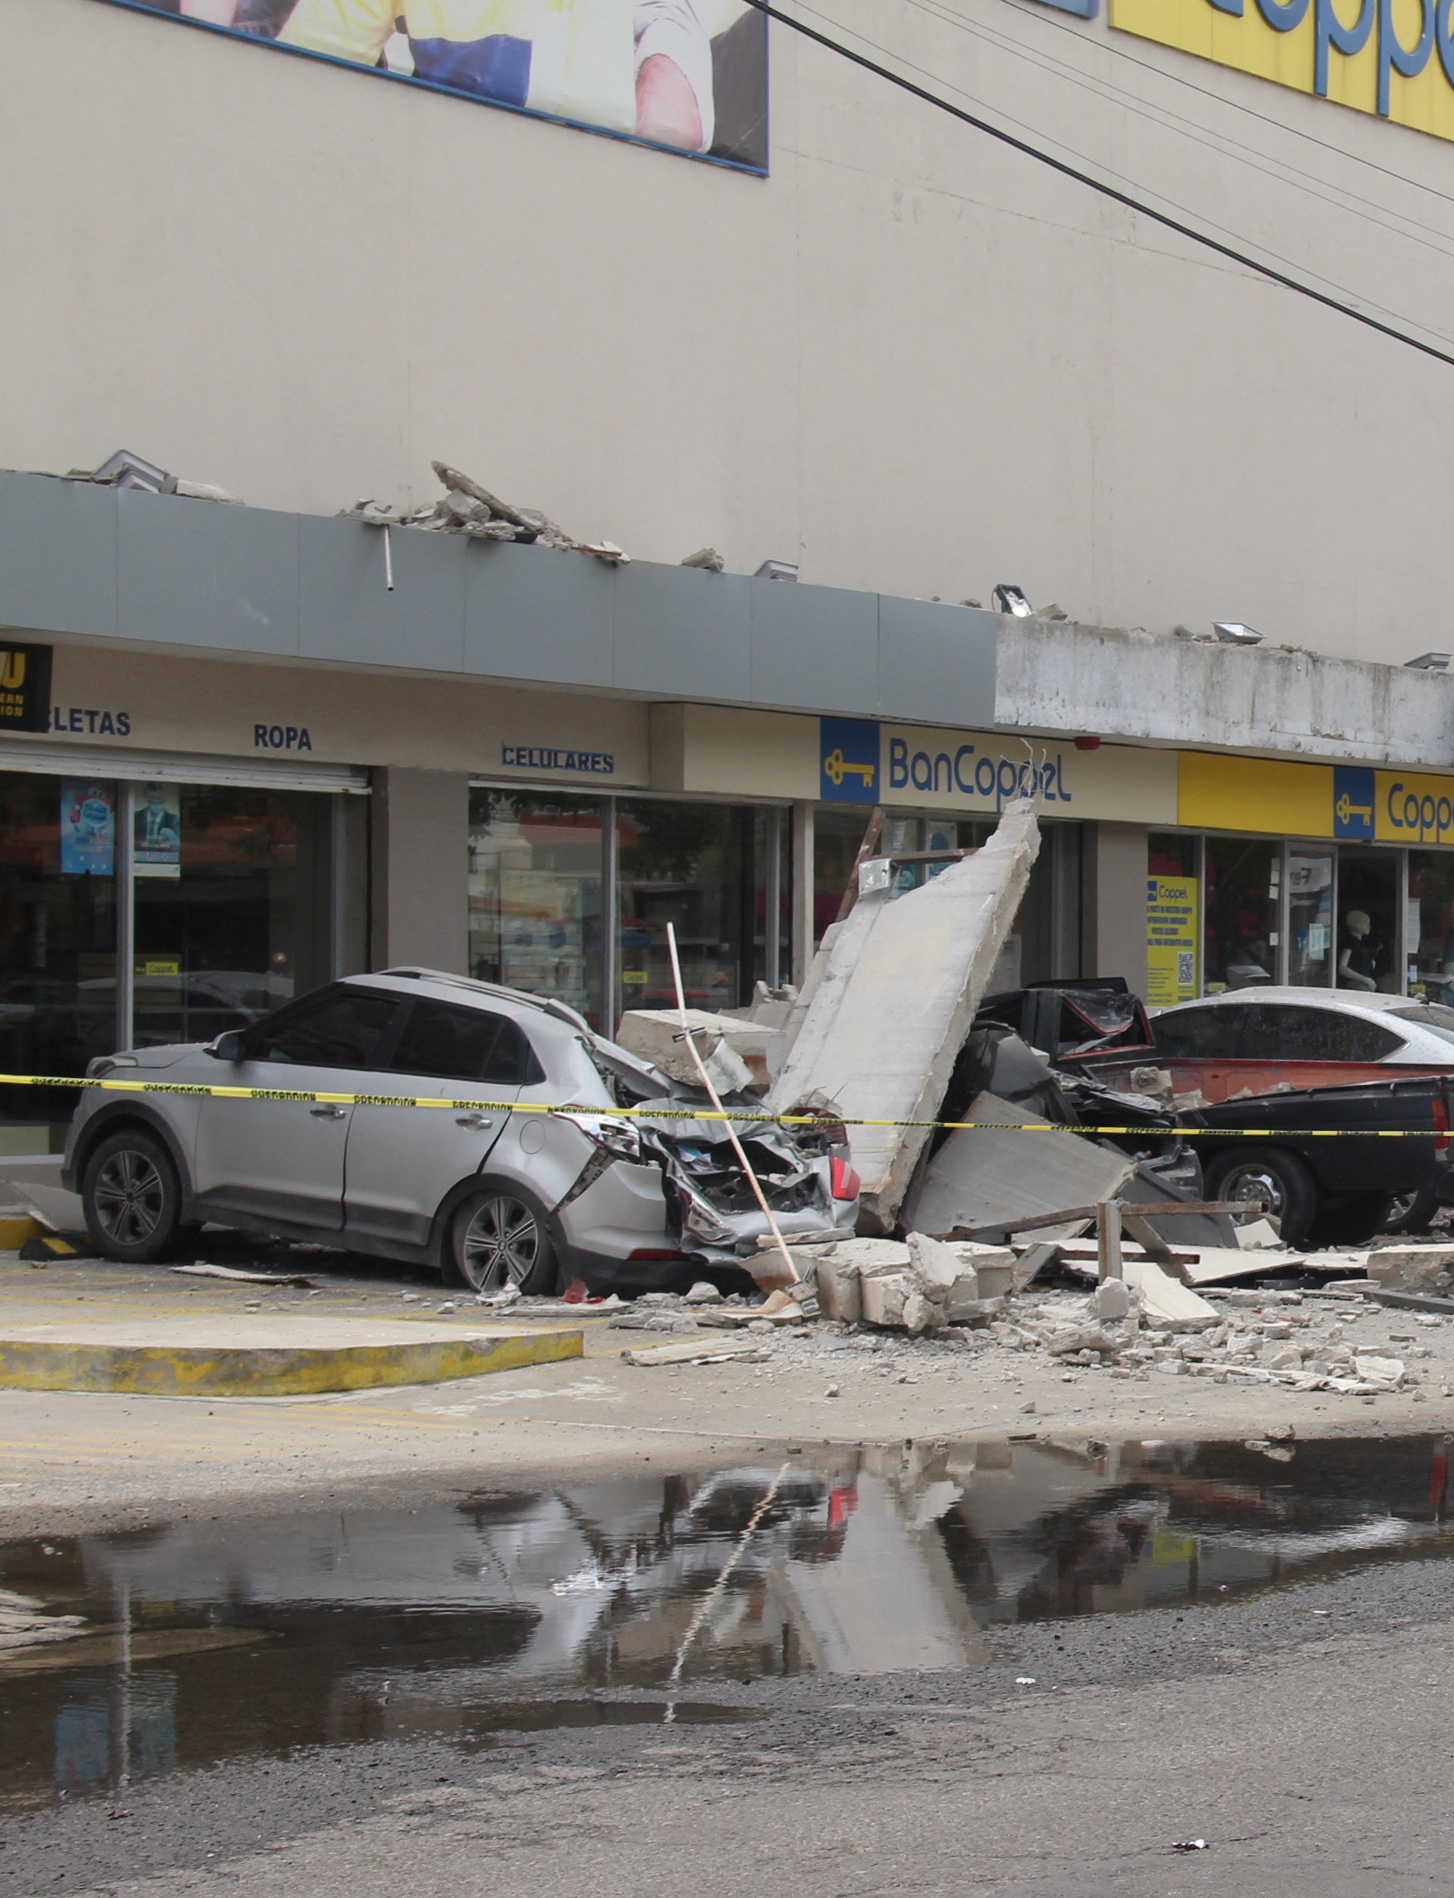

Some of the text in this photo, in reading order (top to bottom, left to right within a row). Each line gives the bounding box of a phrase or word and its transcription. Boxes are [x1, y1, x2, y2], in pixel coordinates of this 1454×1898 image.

[254, 724, 312, 751] ROPA
[502, 743, 614, 774] CELULARES
[890, 738, 1072, 812] BanCoppel
[1159, 885, 1188, 902] Coppel
